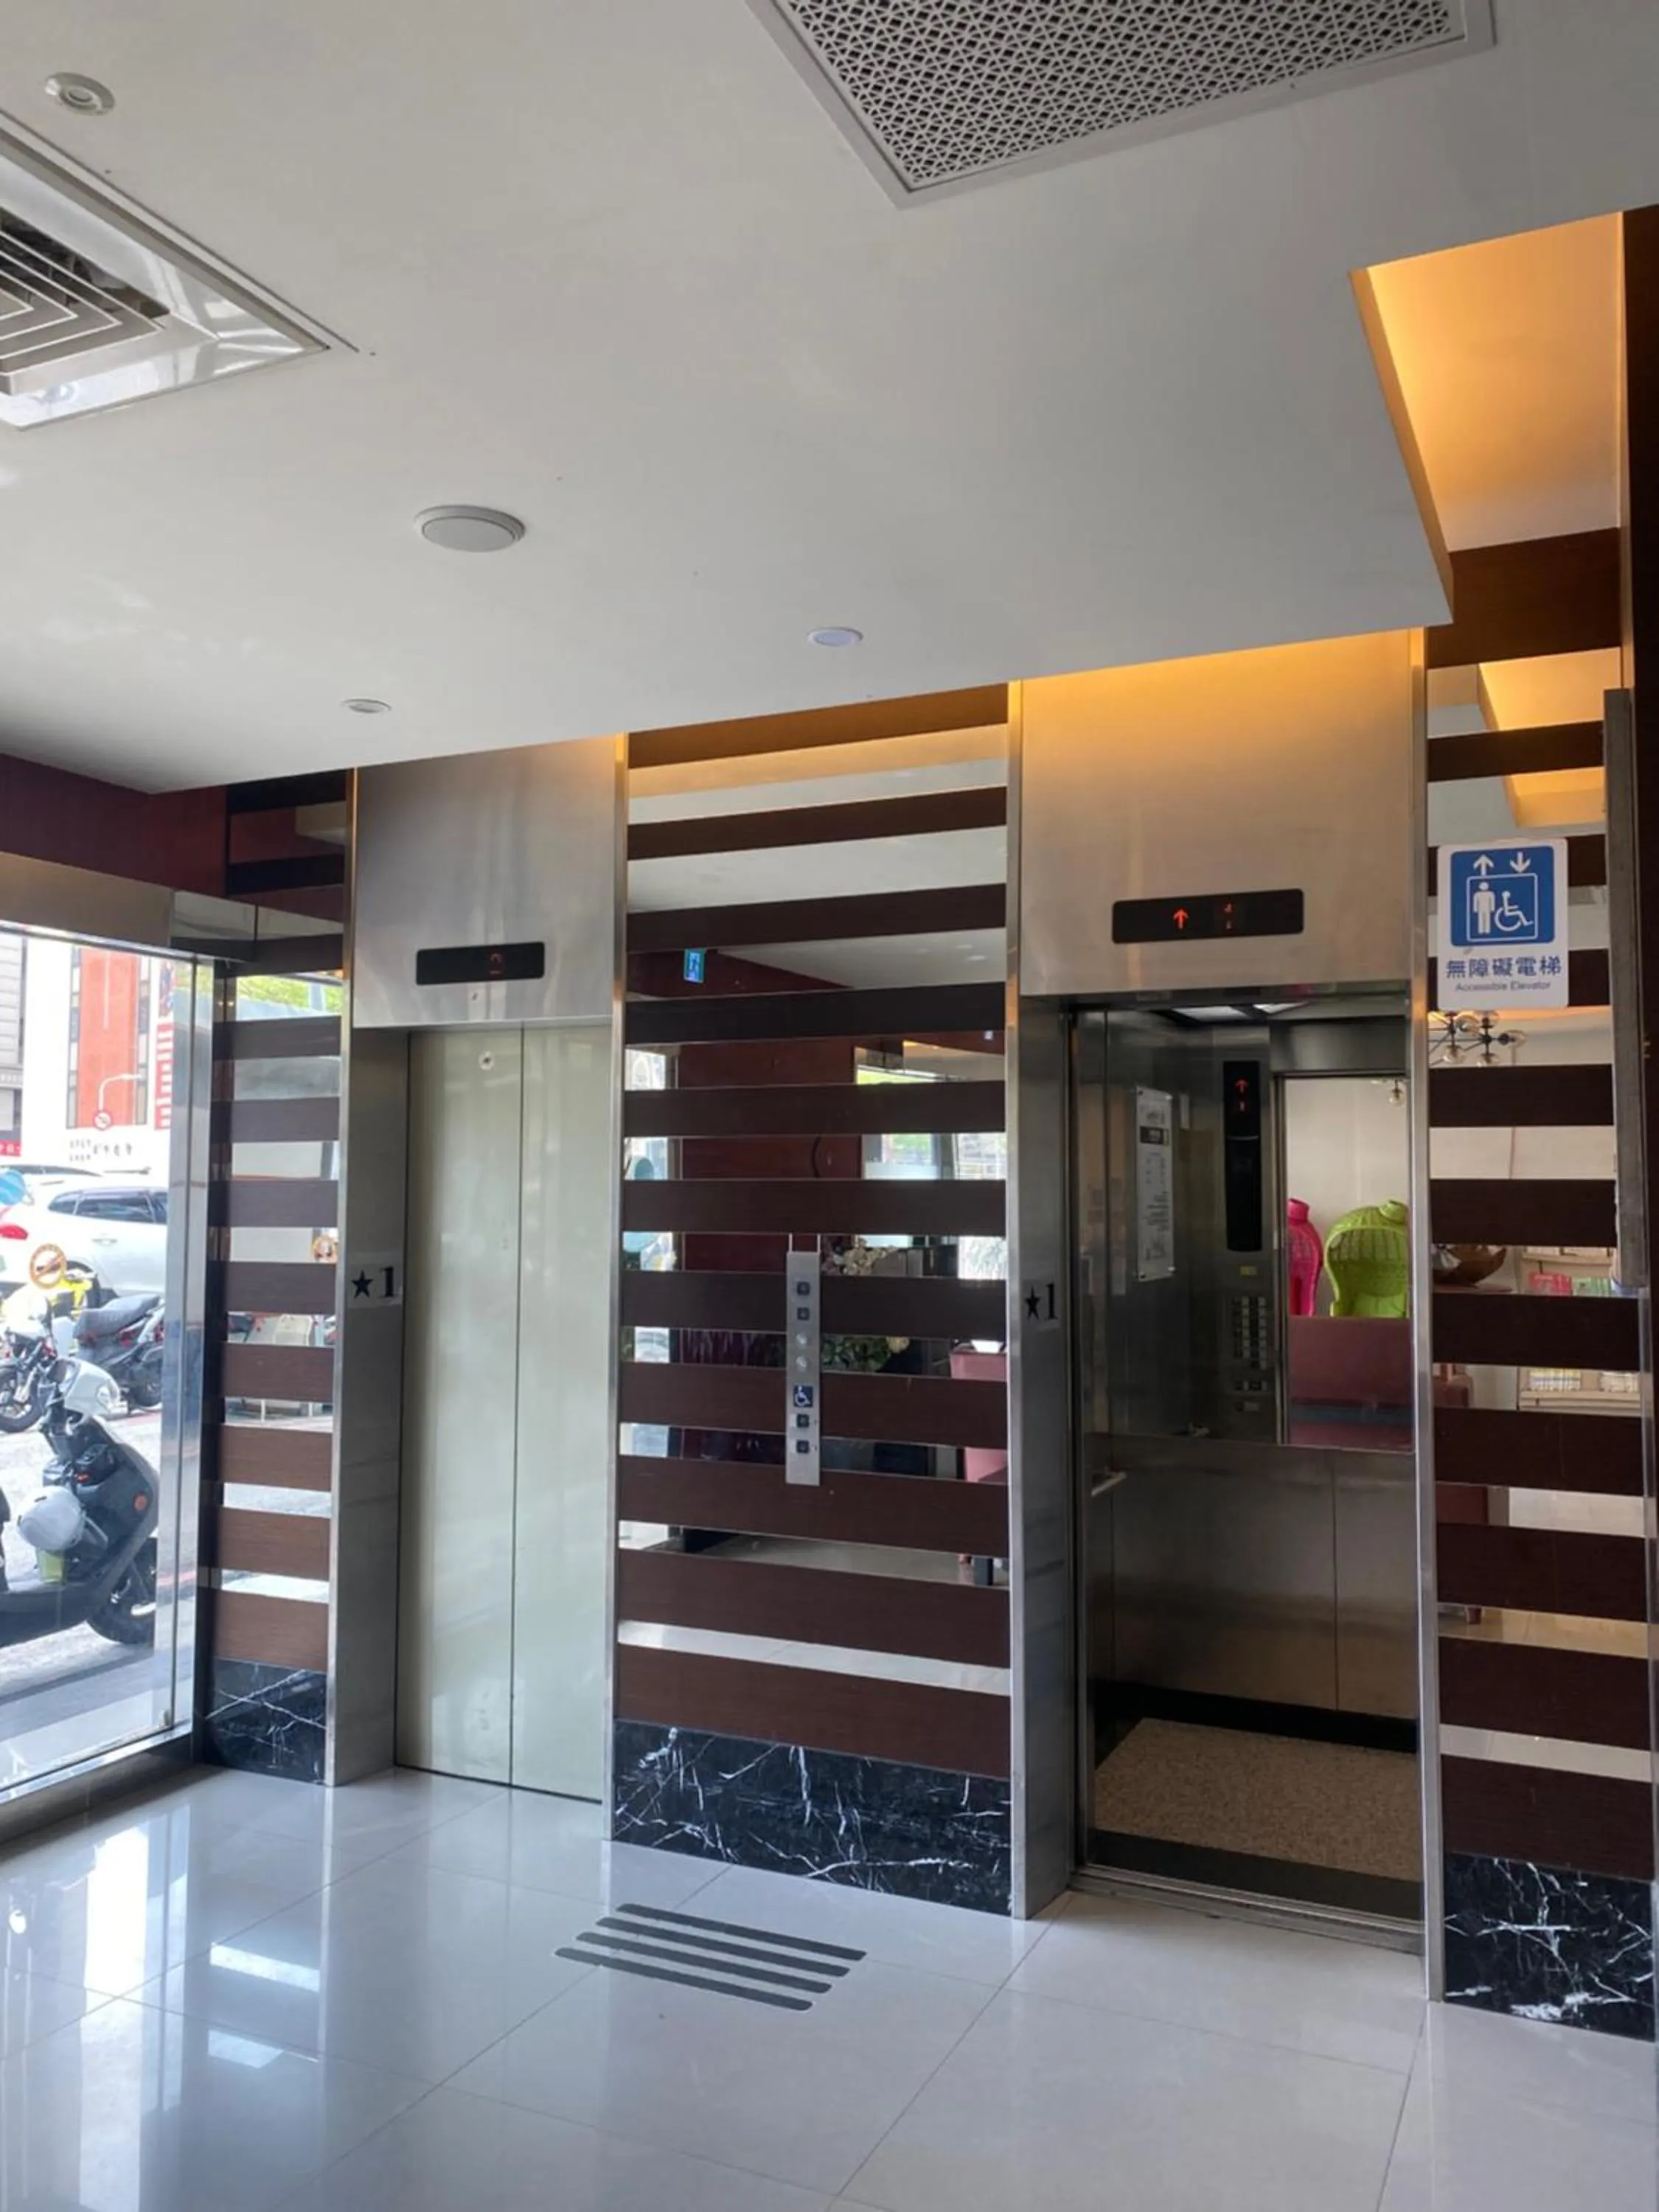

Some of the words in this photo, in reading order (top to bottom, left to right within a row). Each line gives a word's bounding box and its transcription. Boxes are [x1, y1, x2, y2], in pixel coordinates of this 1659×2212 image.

[1447, 956, 1561, 978] 無障礙電梯
[1455, 981, 1507, 992] Accessible
[1510, 981, 1551, 991] Elevator
[379, 1266, 397, 1298] 1
[1044, 1283, 1059, 1320] 1
